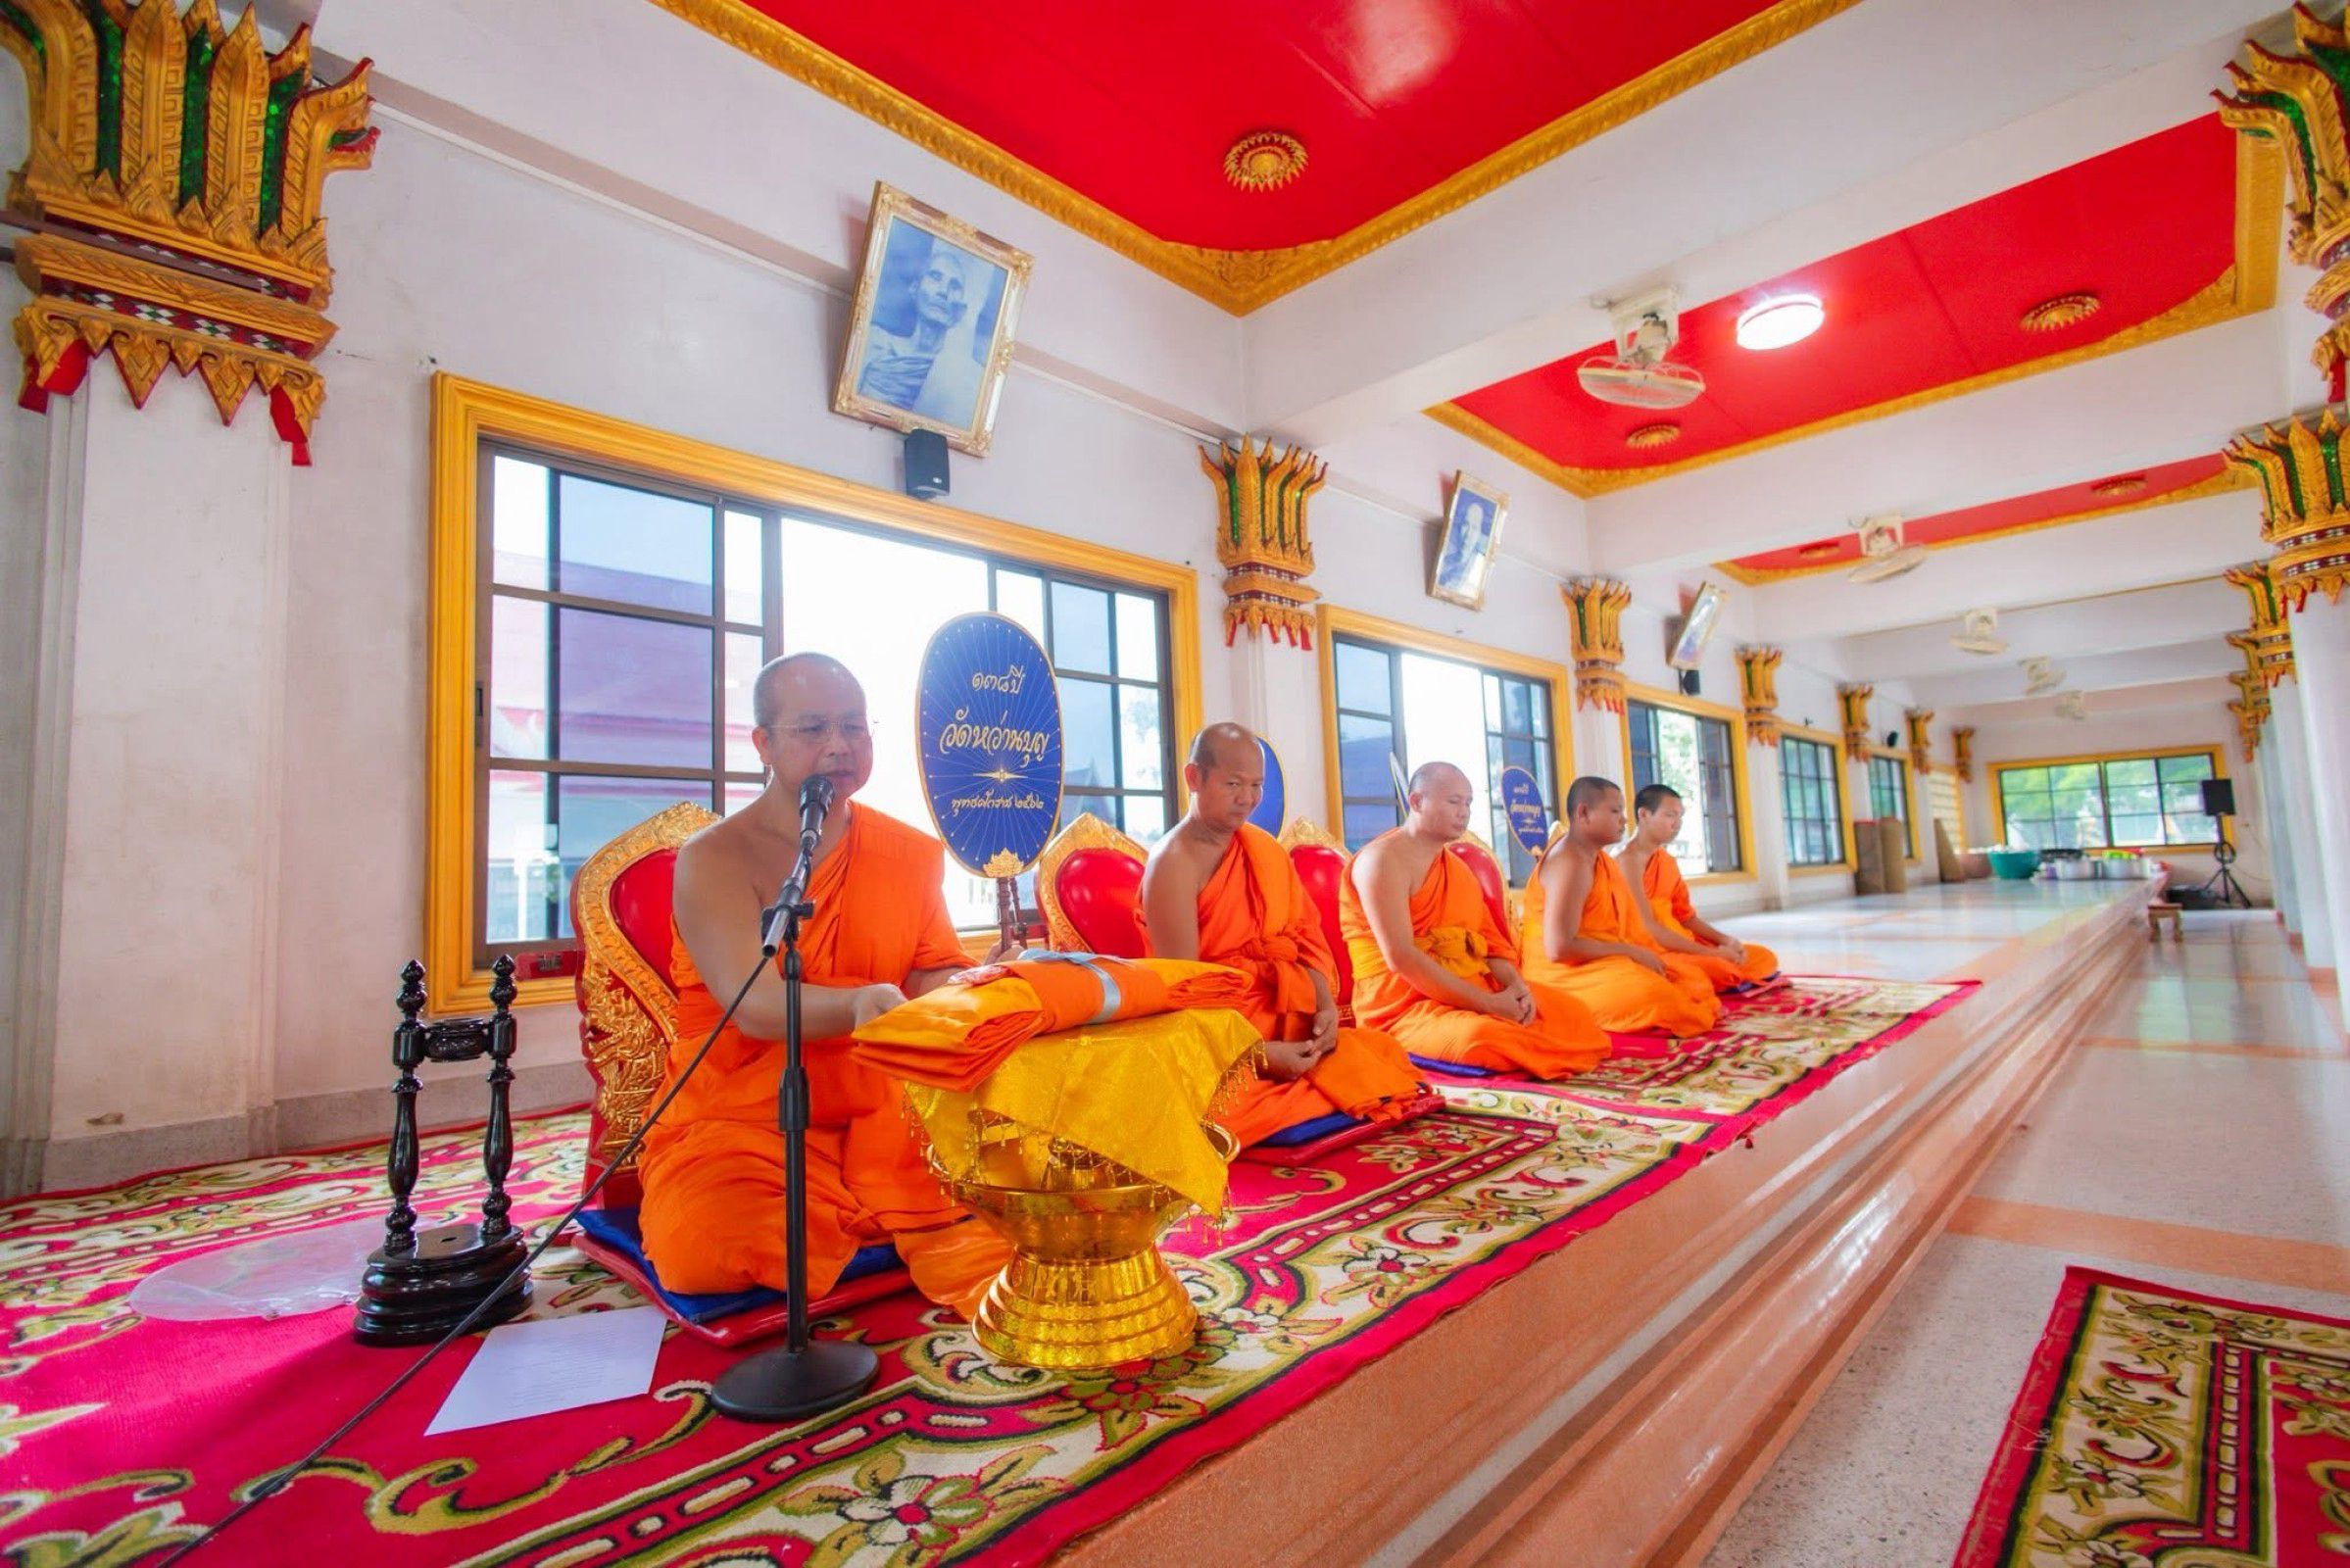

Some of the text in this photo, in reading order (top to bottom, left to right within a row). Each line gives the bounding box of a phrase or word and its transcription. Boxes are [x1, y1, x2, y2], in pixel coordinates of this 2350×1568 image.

[939, 705, 1051, 769] วัดหว่านบุญ
